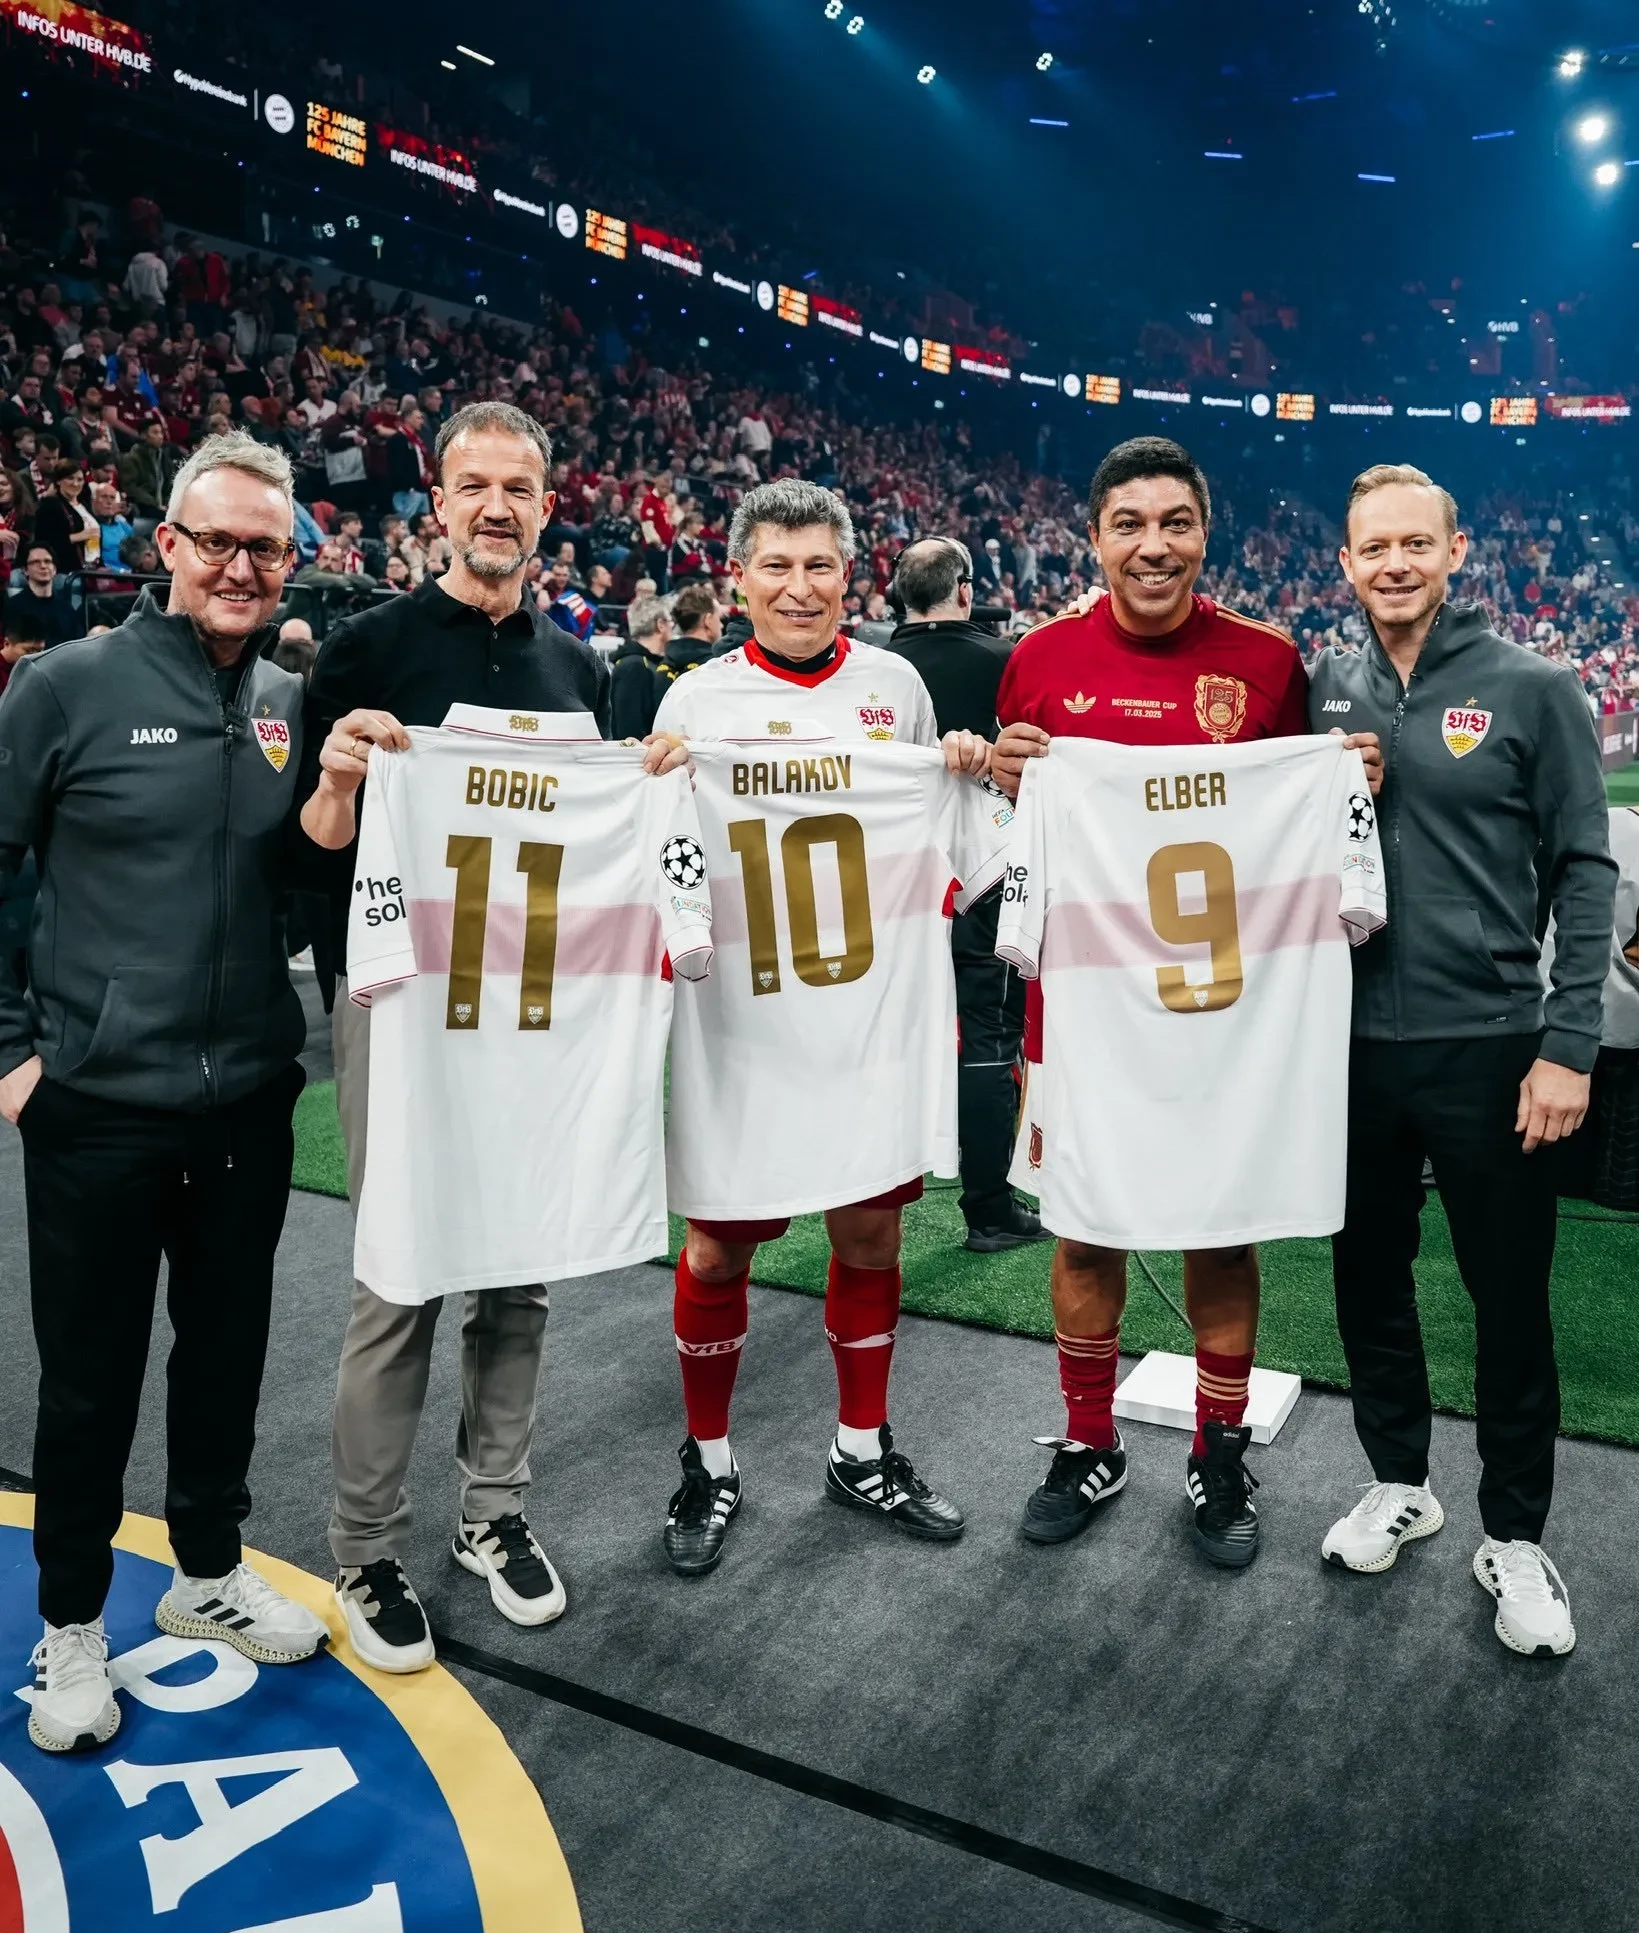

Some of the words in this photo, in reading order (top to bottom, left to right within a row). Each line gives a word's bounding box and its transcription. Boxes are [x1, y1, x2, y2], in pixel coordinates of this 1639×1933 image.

[17, 9, 59, 39] INFOS
[60, 26, 104, 56] UNTER
[105, 43, 152, 73] HVB.DE
[307, 101, 330, 120] 125
[332, 111, 366, 137] JAHRE
[307, 117, 323, 136] FC
[1111, 698, 1161, 709] BECKENBAUER
[1162, 701, 1177, 710] CUP
[1211, 687, 1234, 703] 125
[1322, 699, 1352, 713] JAKO
[1124, 708, 1162, 719] 17.03.2025
[130, 728, 178, 745] JAKO
[465, 765, 559, 813] BOBIC
[732, 754, 852, 797] BALAKOV
[1144, 771, 1227, 813] ELBER
[727, 812, 875, 997] 10
[445, 833, 565, 1031] 11
[1145, 841, 1244, 1015] 9
[682, 1341, 736, 1355] VfB
